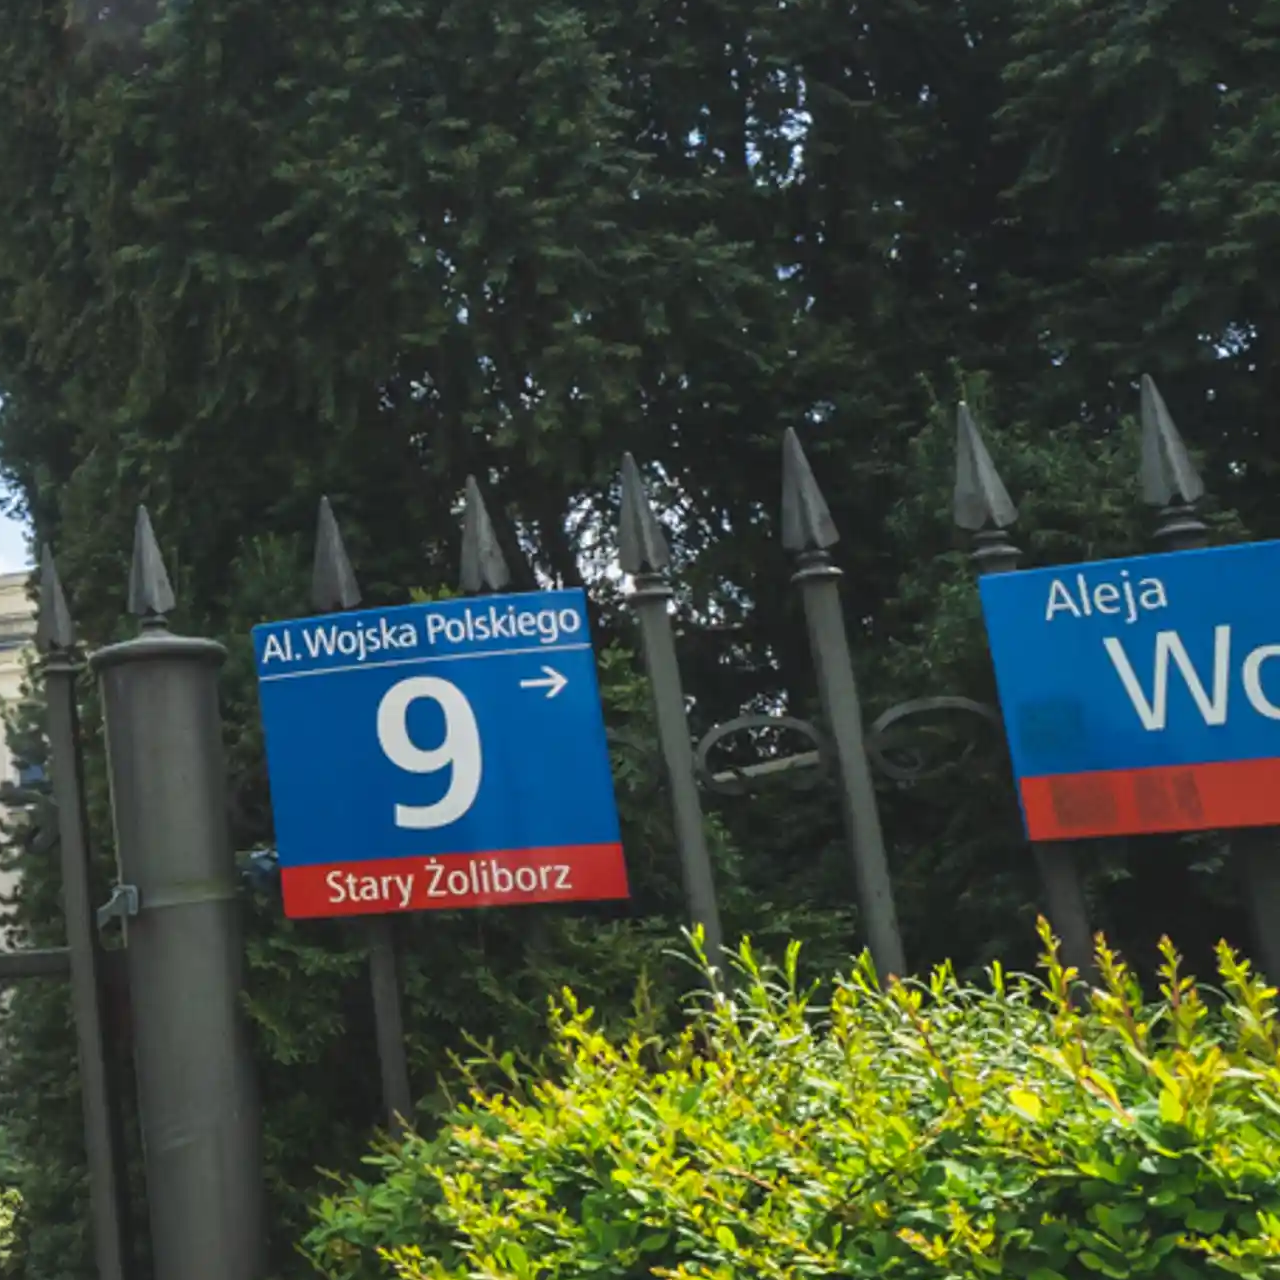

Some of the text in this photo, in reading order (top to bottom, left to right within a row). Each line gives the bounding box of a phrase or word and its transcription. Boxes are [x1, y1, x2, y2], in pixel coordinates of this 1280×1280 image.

[1045, 570, 1168, 624] Aleja
[262, 605, 581, 663] Al. Wojska Polskiego
[376, 676, 483, 830] 9
[326, 858, 572, 907] Stary Żoliborz
